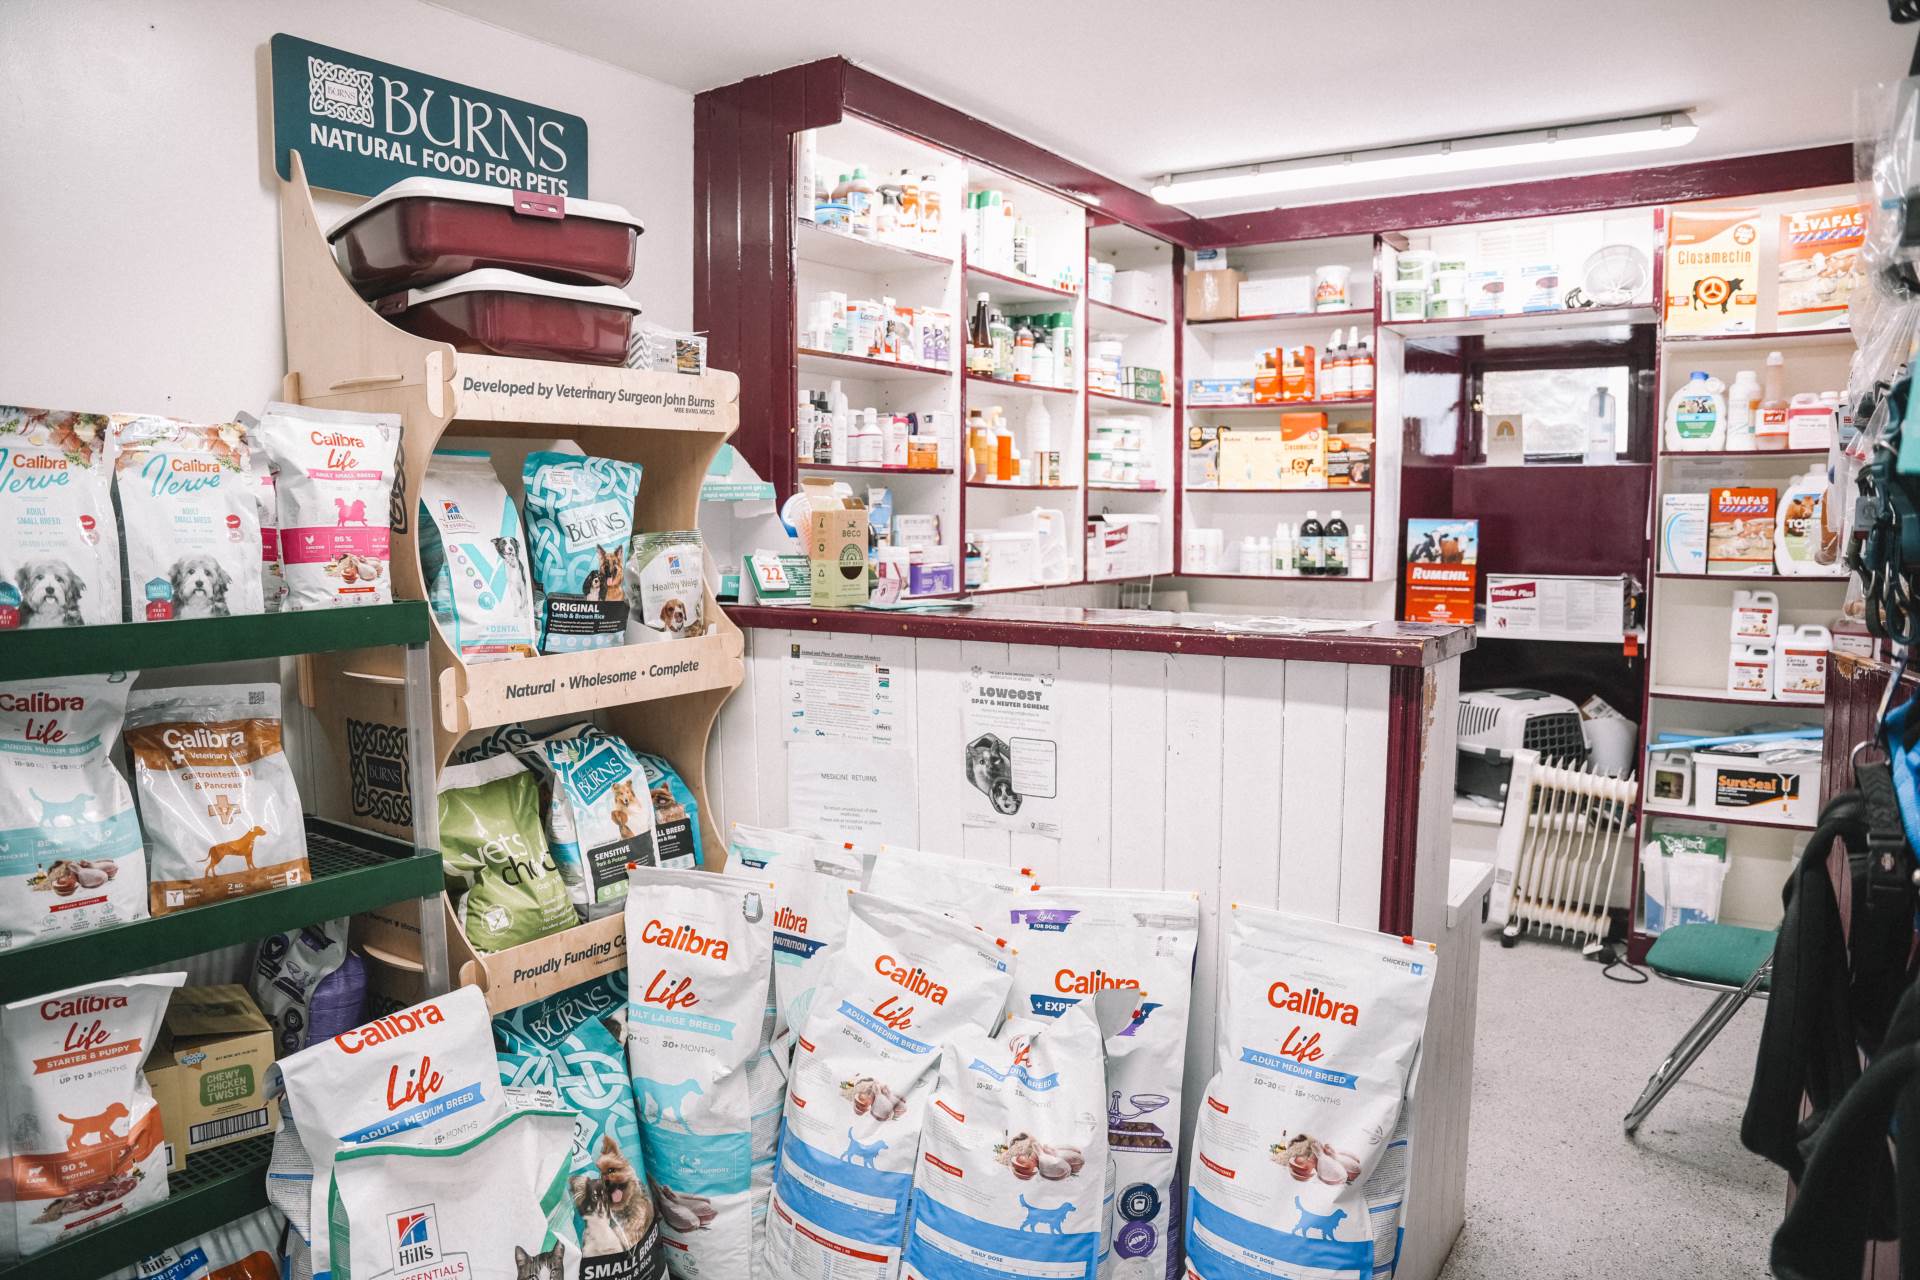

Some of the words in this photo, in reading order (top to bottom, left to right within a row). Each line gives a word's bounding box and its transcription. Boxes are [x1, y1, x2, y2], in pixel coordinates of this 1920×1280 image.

[379, 76, 567, 172] BURNS
[310, 123, 417, 166] NATURAL
[422, 148, 481, 178] FOOD
[485, 166, 522, 188] FOR
[526, 175, 568, 197] PETS
[1790, 211, 1864, 232] LEVAFAS
[1678, 249, 1751, 265] Closamectin
[463, 377, 534, 397] Developed
[537, 382, 553, 399] by
[555, 384, 616, 403] Veterinary
[618, 388, 662, 406] Surgeon
[663, 393, 685, 407] John
[688, 394, 715, 408] Burns
[310, 430, 365, 449] Calibra
[13, 454, 68, 470] Calibra
[171, 459, 221, 473] Calibra
[327, 448, 359, 471] Life
[141, 453, 221, 497] Verve
[1719, 496, 1769, 505] LEVAFAS
[566, 512, 625, 543] BURNS
[763, 567, 783, 580] 22
[552, 602, 600, 613] ORIGINAL
[505, 679, 556, 699] Natural
[568, 667, 637, 690] Wholesome
[649, 659, 699, 679] Complete
[0, 692, 84, 713] Calibra
[979, 686, 1042, 702] LOWCOST
[1022, 702, 1050, 711] SCHEME
[25, 718, 69, 744] Life
[163, 728, 245, 748] Calibra
[190, 751, 227, 760] Veterinary
[181, 769, 253, 781] Gatrointestial
[368, 764, 401, 785] BURNS
[577, 757, 624, 798] BURNS
[851, 774, 878, 782] RETURNS
[1718, 775, 1777, 791] SureSeal
[204, 782, 242, 790] Pancreas
[665, 824, 686, 836] BREED
[594, 845, 631, 861] SENSITIVE
[641, 918, 729, 961] Calibra
[773, 936, 808, 952] NUTRITION
[513, 955, 560, 983] Proudly
[563, 941, 611, 966] Funding
[1382, 955, 1411, 969] CHICKEN
[643, 968, 701, 1010] Life
[875, 954, 949, 1006] Calibra
[1054, 968, 1140, 995] Calibra
[40, 994, 129, 1022] Calibra
[872, 995, 913, 1030] Life
[1045, 1001, 1073, 1013] EXPE
[1267, 980, 1360, 1027] Calibra
[529, 985, 611, 1044] BURNS
[652, 1012, 686, 1026] LARGE
[690, 1019, 721, 1033] BREED
[63, 1019, 112, 1052] Life
[334, 1004, 445, 1055] Calibra
[846, 1006, 872, 1028] ADULT
[872, 1022, 900, 1045] MEDIUM
[662, 1039, 679, 1049] 30+
[1279, 1025, 1325, 1064] Life
[47, 1052, 87, 1069] STARTER
[99, 1045, 130, 1058] PUPPY
[59, 1077, 70, 1085] UP
[74, 1074, 85, 1082] TO
[207, 1069, 240, 1084] CHEWY
[1250, 1054, 1281, 1068] ADULT
[1281, 1062, 1313, 1077] MEDIUM
[1314, 1070, 1347, 1084] BREED
[207, 1076, 247, 1093] CHICKEN
[207, 1085, 248, 1102] TWISTS
[385, 1056, 445, 1112] Life
[1027, 1079, 1052, 1089] BREED
[1253, 1077, 1277, 1090] 10-30
[1306, 1093, 1342, 1106] MONTHS
[359, 1123, 400, 1144] ADULT
[404, 1103, 444, 1127] MEDIUM
[446, 1092, 475, 1111] BREED
[398, 1245, 434, 1267] Hill's
[583, 1257, 639, 1280] SMALL
[639, 1223, 659, 1259] BREED
[986, 1254, 1003, 1263] DOSE
[1258, 1255, 1276, 1267] DOSE
[141, 1254, 173, 1275] Hill's
